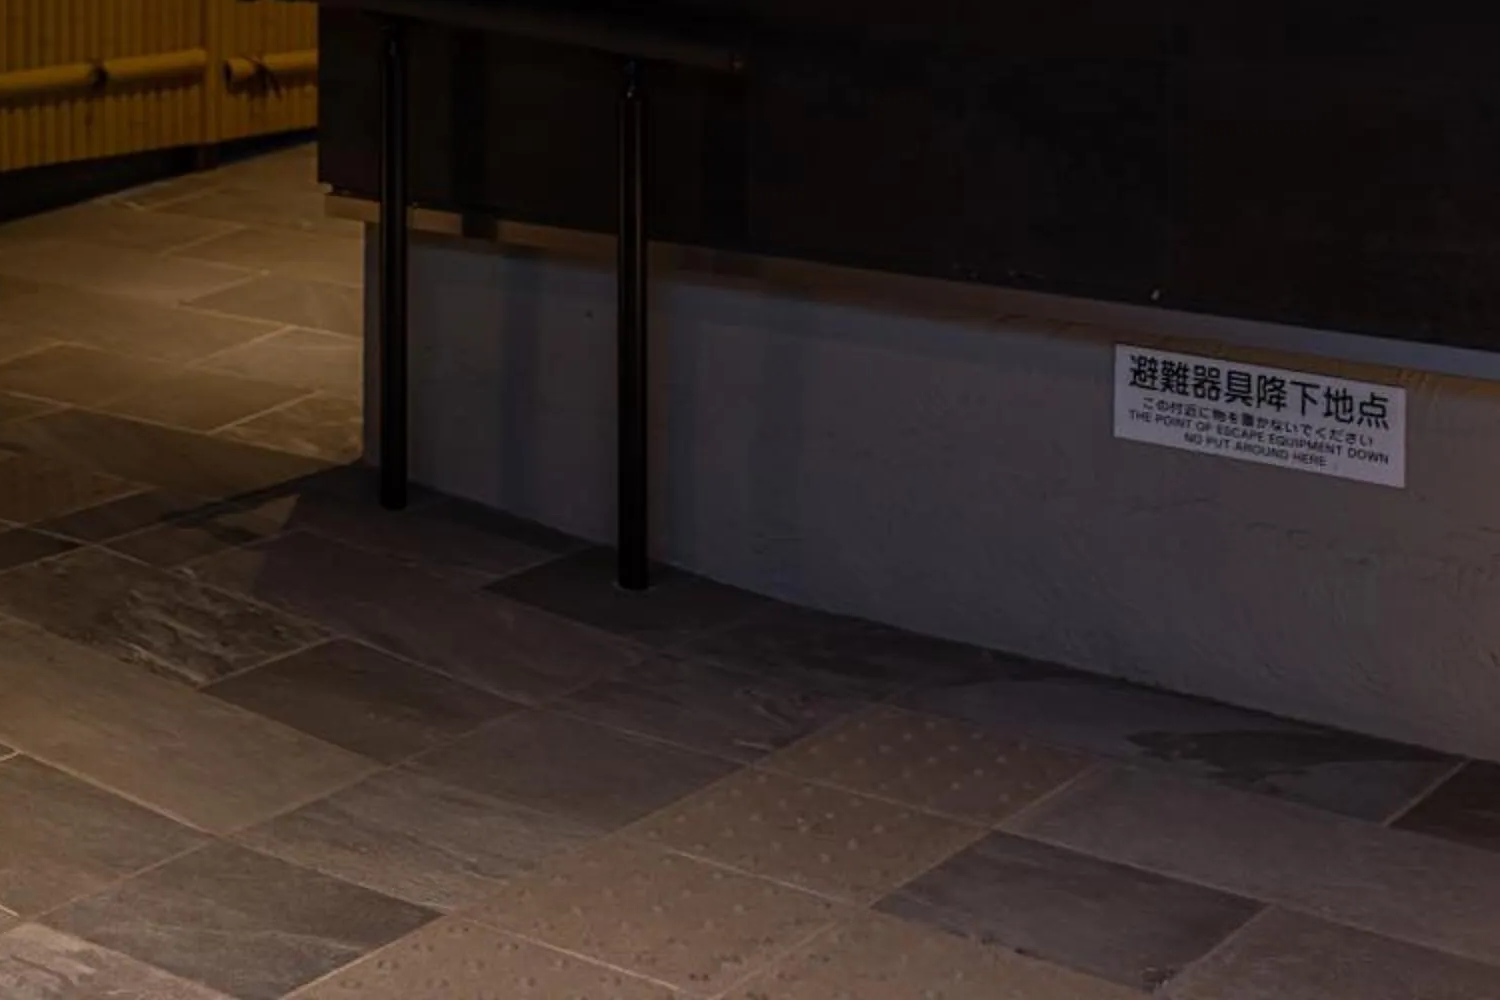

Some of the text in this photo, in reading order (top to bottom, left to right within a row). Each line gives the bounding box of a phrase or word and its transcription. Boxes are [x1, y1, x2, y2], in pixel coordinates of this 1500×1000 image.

[1129, 355, 1389, 430] 避難器具降下地点
[1129, 409, 1390, 465] THE POINT OF ESCAPE EQUIPMENT DOWN
[1184, 432, 1327, 467] NO PUT AROUND HERE
